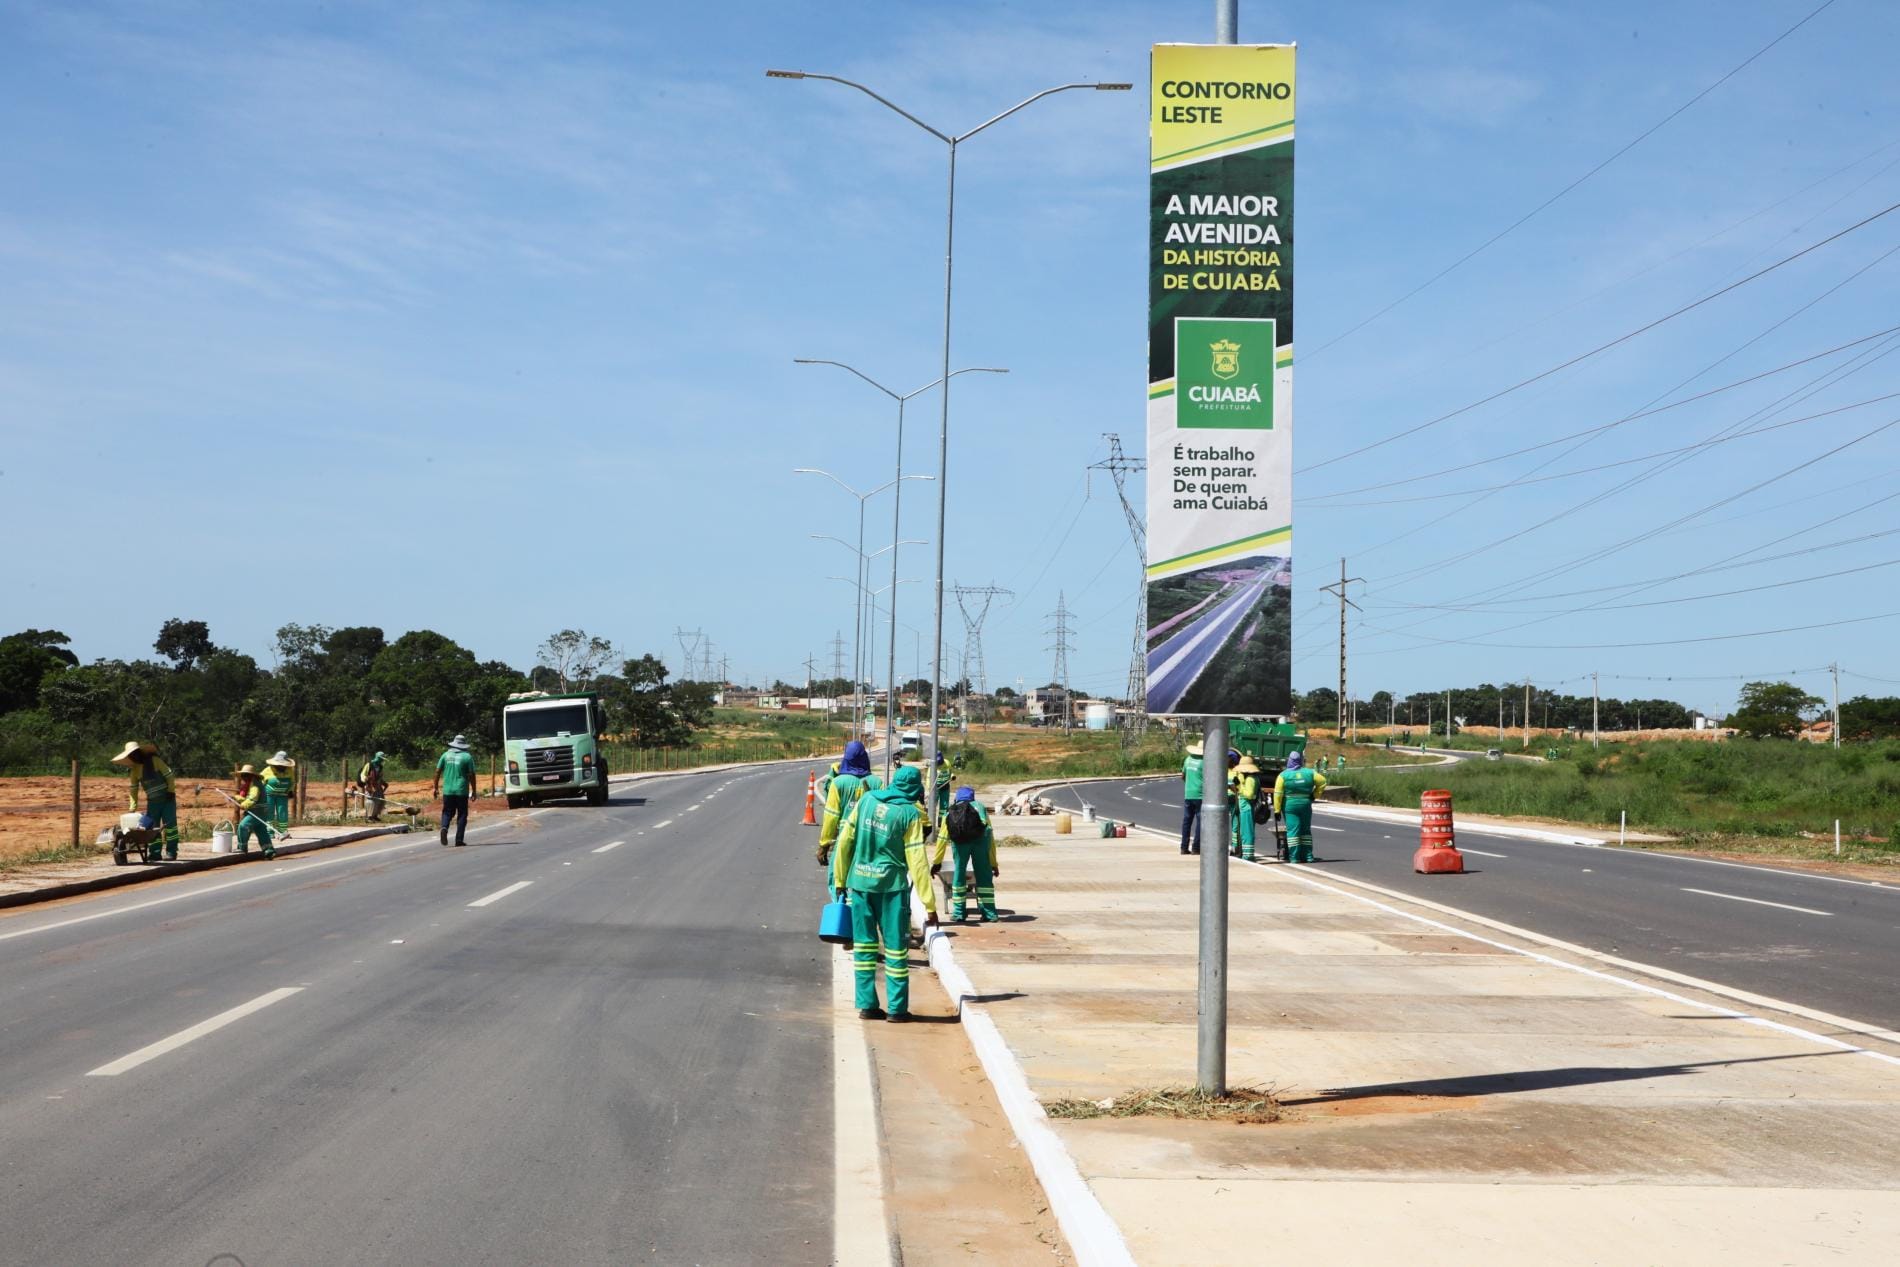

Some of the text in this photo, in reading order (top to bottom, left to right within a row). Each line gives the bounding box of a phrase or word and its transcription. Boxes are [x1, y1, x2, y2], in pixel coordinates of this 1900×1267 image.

[1161, 81, 1291, 100] CONTORNO
[1162, 106, 1222, 123] LESTE
[1165, 195, 1278, 217] A MAIOR
[1164, 223, 1281, 245] AVENIDA
[1164, 247, 1280, 266] DA HISTÓRIA
[1164, 270, 1280, 291] DE CUIABÁ
[1189, 384, 1261, 403] CUIABÁ
[1174, 443, 1254, 461] É trabalho
[1174, 466, 1256, 480] sem parar.
[1174, 479, 1247, 497] De quem
[1173, 496, 1268, 510] ama Cuiabá
